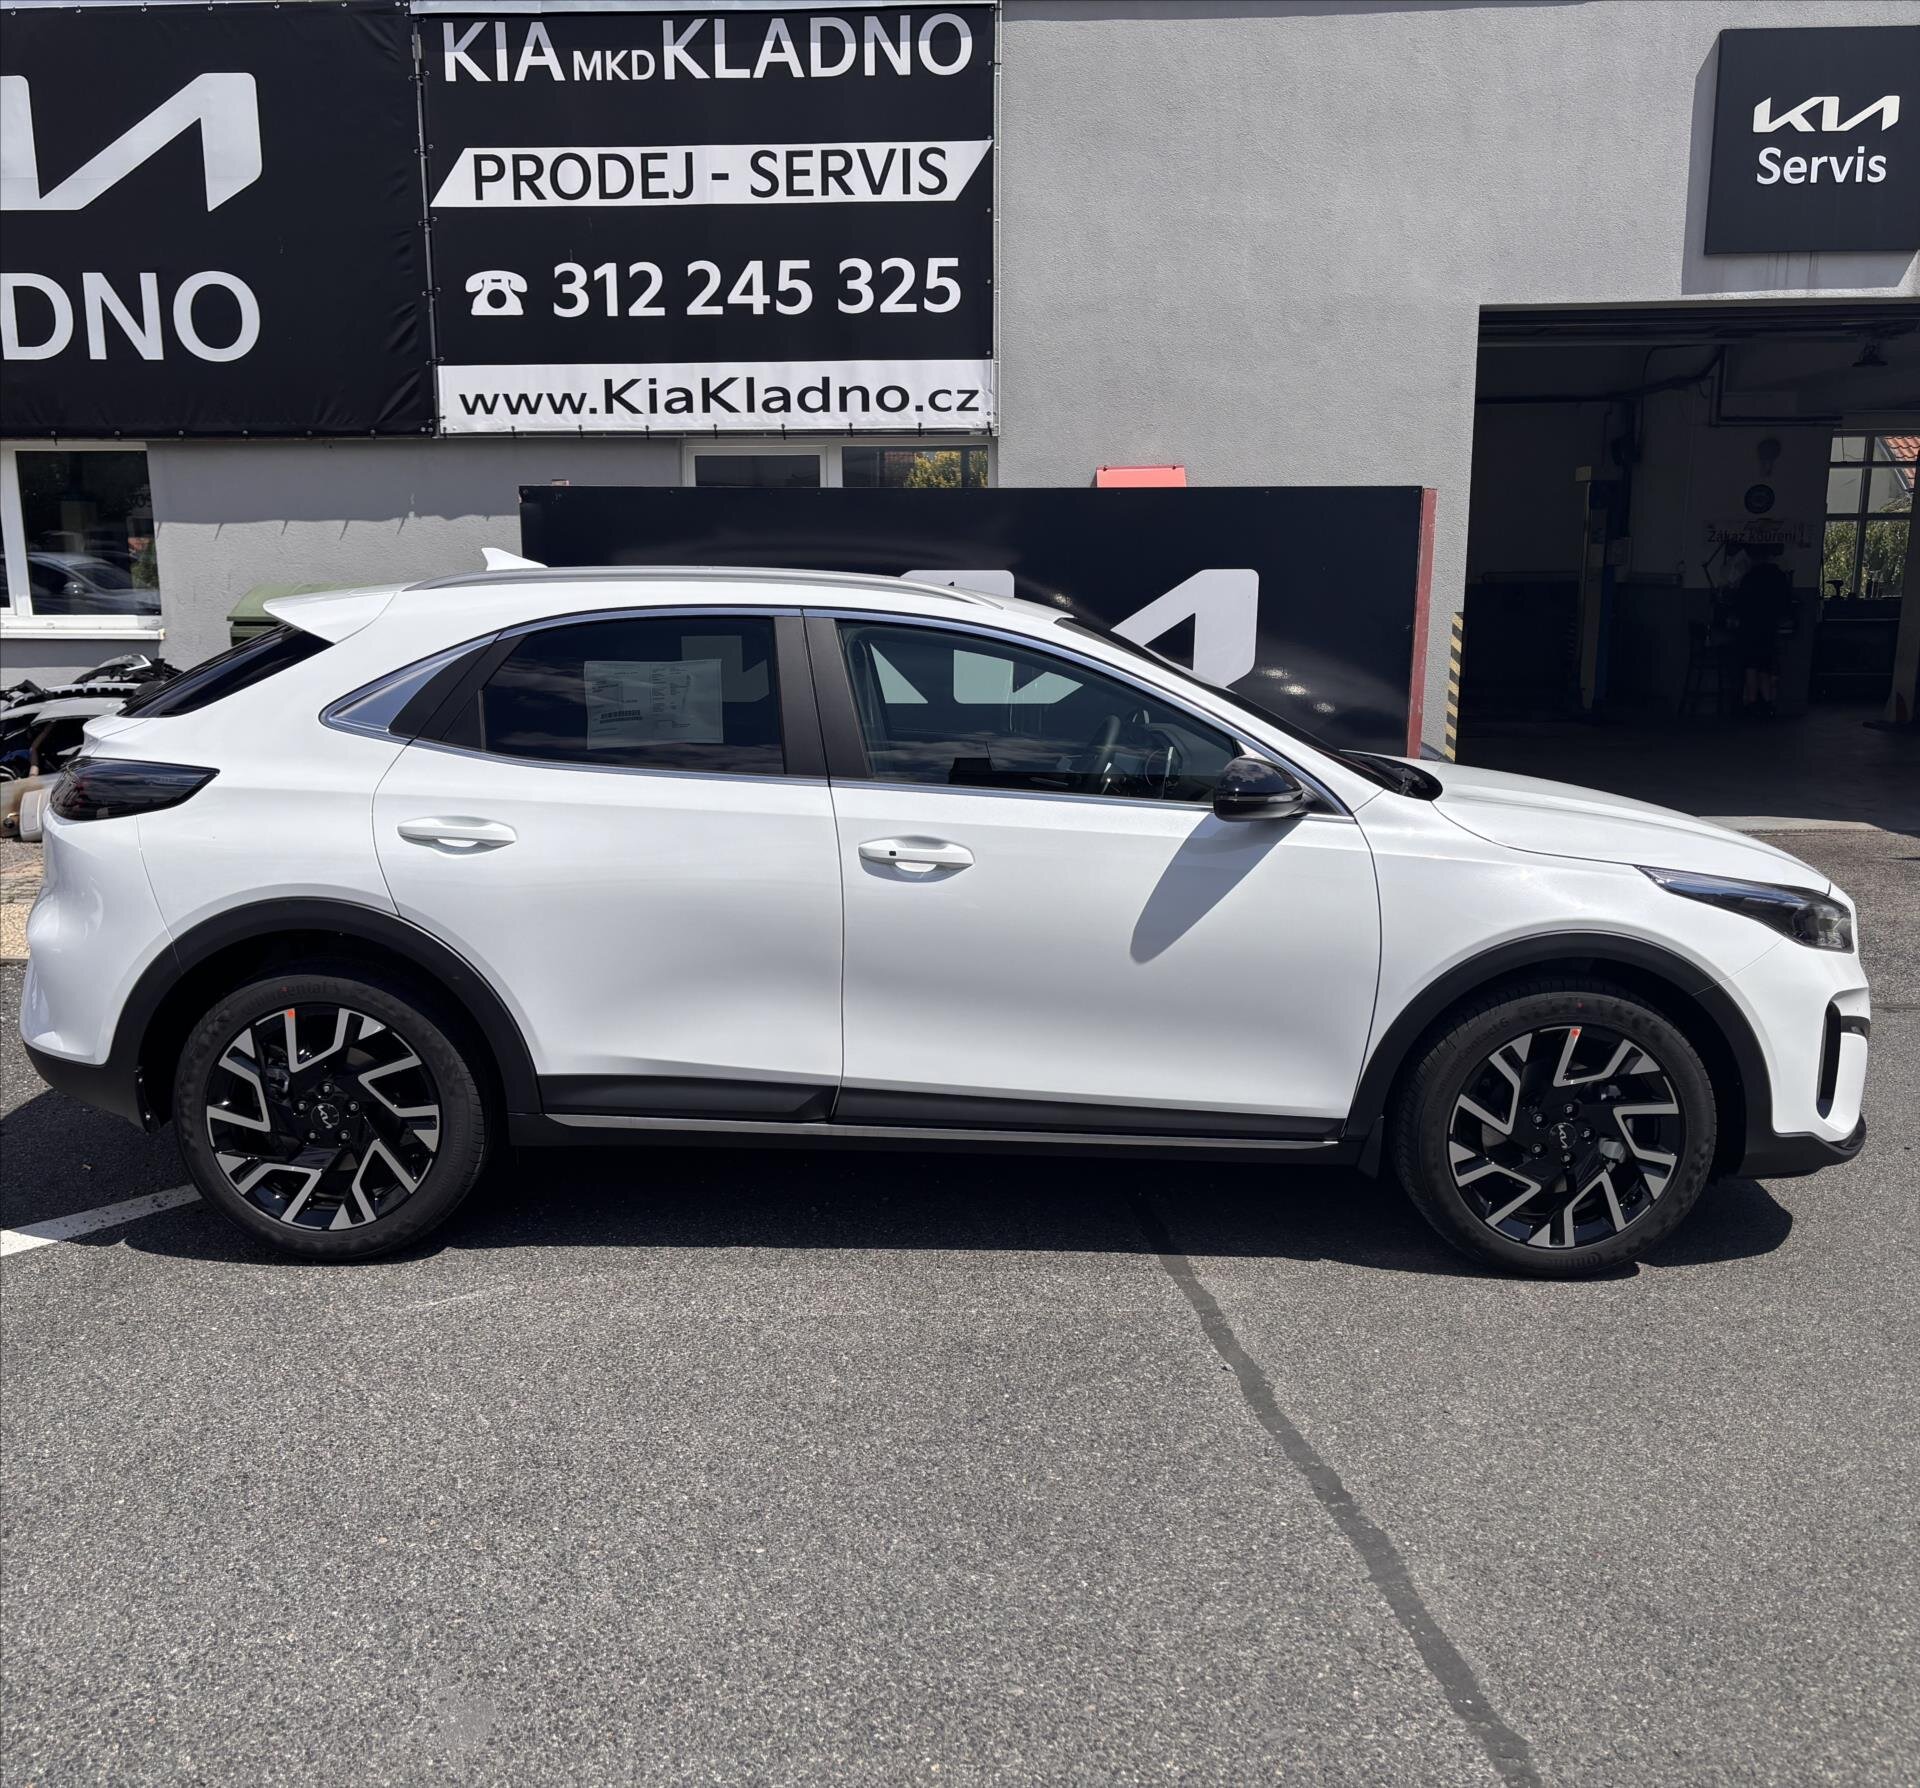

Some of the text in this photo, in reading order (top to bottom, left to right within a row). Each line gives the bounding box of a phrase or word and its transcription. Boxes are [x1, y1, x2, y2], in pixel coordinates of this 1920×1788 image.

[443, 12, 973, 82] KIA MKD KLADNO
[1752, 95, 1900, 133] KIA
[473, 146, 948, 201] PRODEJ - SERVIS
[1756, 145, 1887, 185] Servis
[553, 257, 962, 318] 312 245 325
[459, 376, 980, 416] www.KiaKladno.cz
